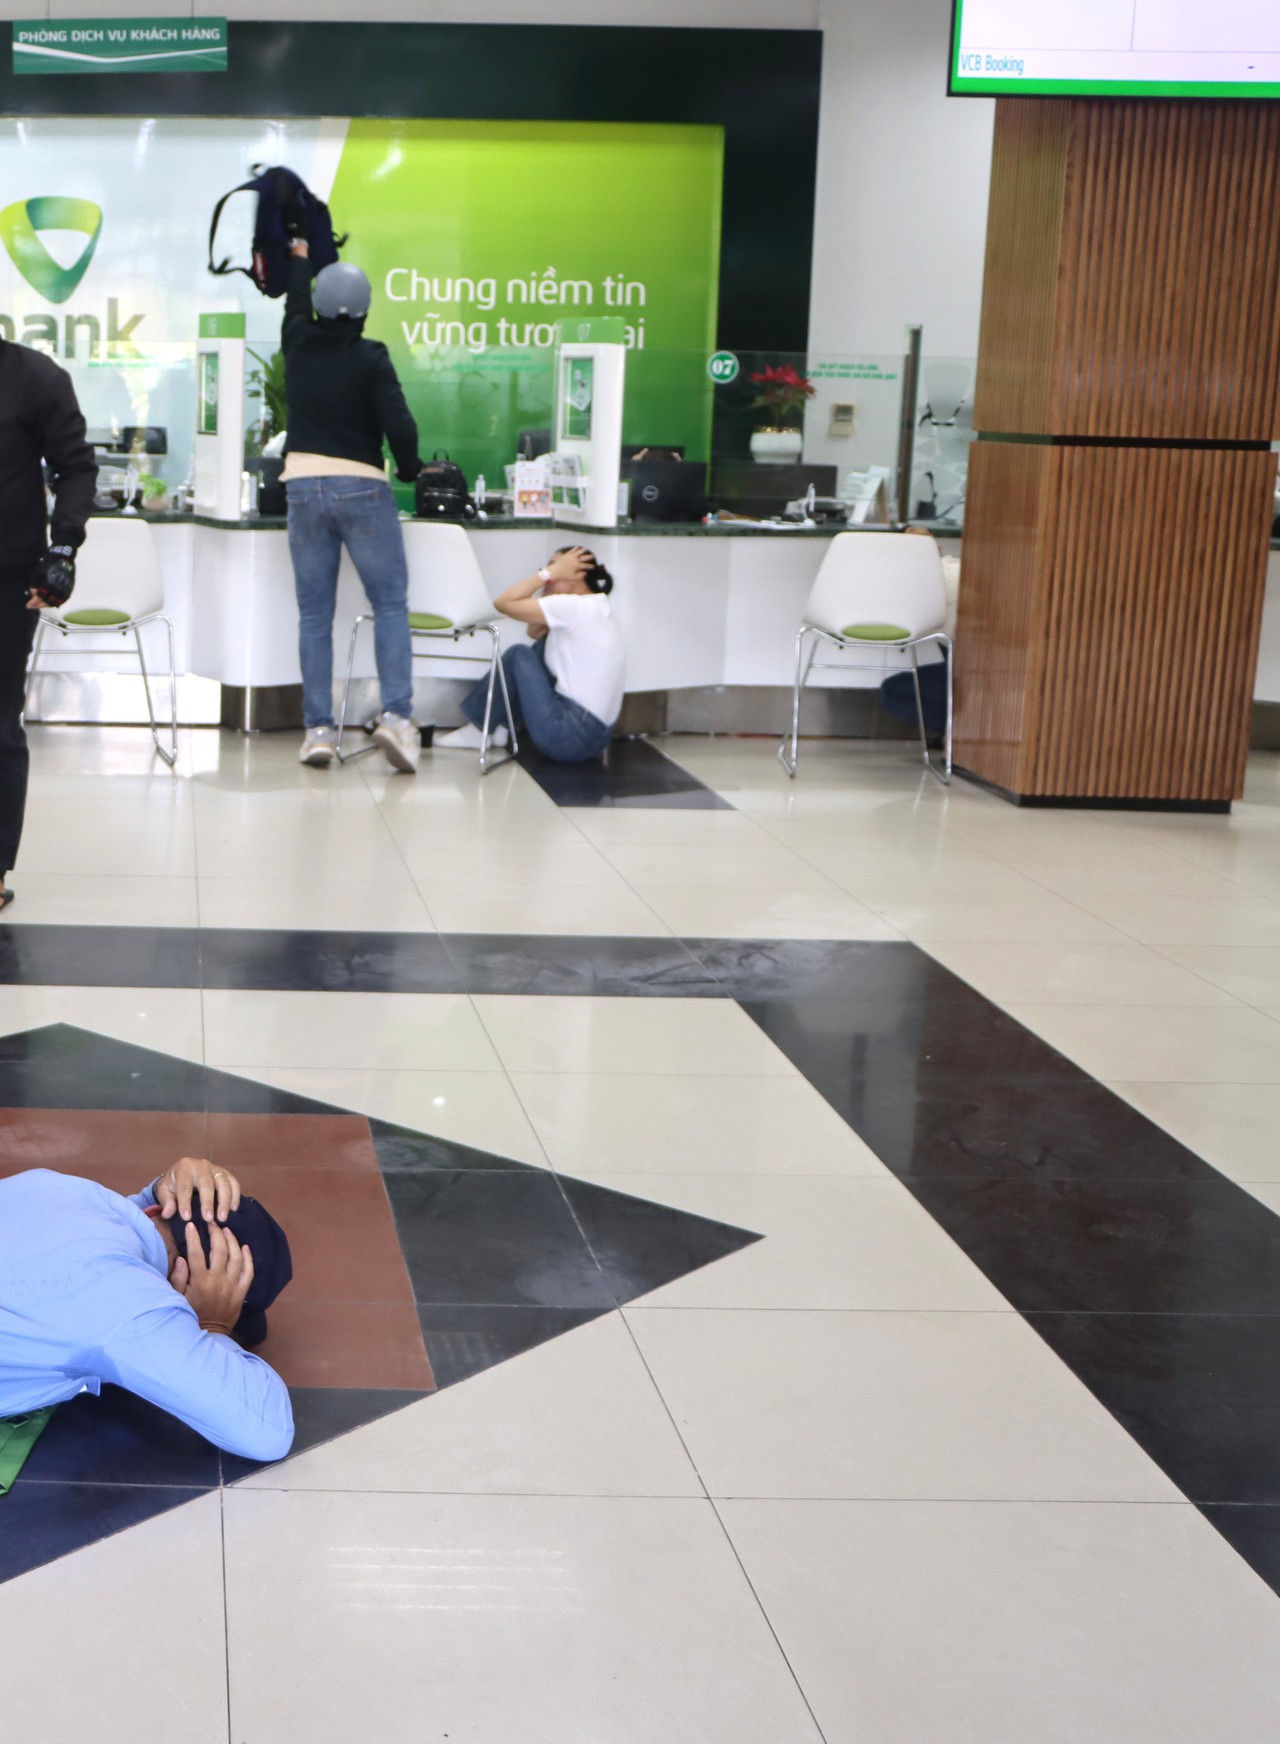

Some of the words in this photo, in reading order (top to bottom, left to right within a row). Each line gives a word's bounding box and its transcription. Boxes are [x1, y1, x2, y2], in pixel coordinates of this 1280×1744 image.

[18, 27, 67, 43] PHÒNG
[71, 29, 104, 43] DỊCH
[107, 29, 127, 42] VỤ
[130, 25, 178, 41] KHÁCH
[181, 25, 221, 41] HÀNG
[961, 53, 982, 71] VCB
[985, 53, 1024, 75] Booking
[385, 267, 497, 311] Chung
[506, 265, 593, 306] niềm
[603, 273, 646, 307] tin
[401, 312, 488, 353] vững
[496, 317, 560, 348] tươ
[712, 359, 734, 375] 07
